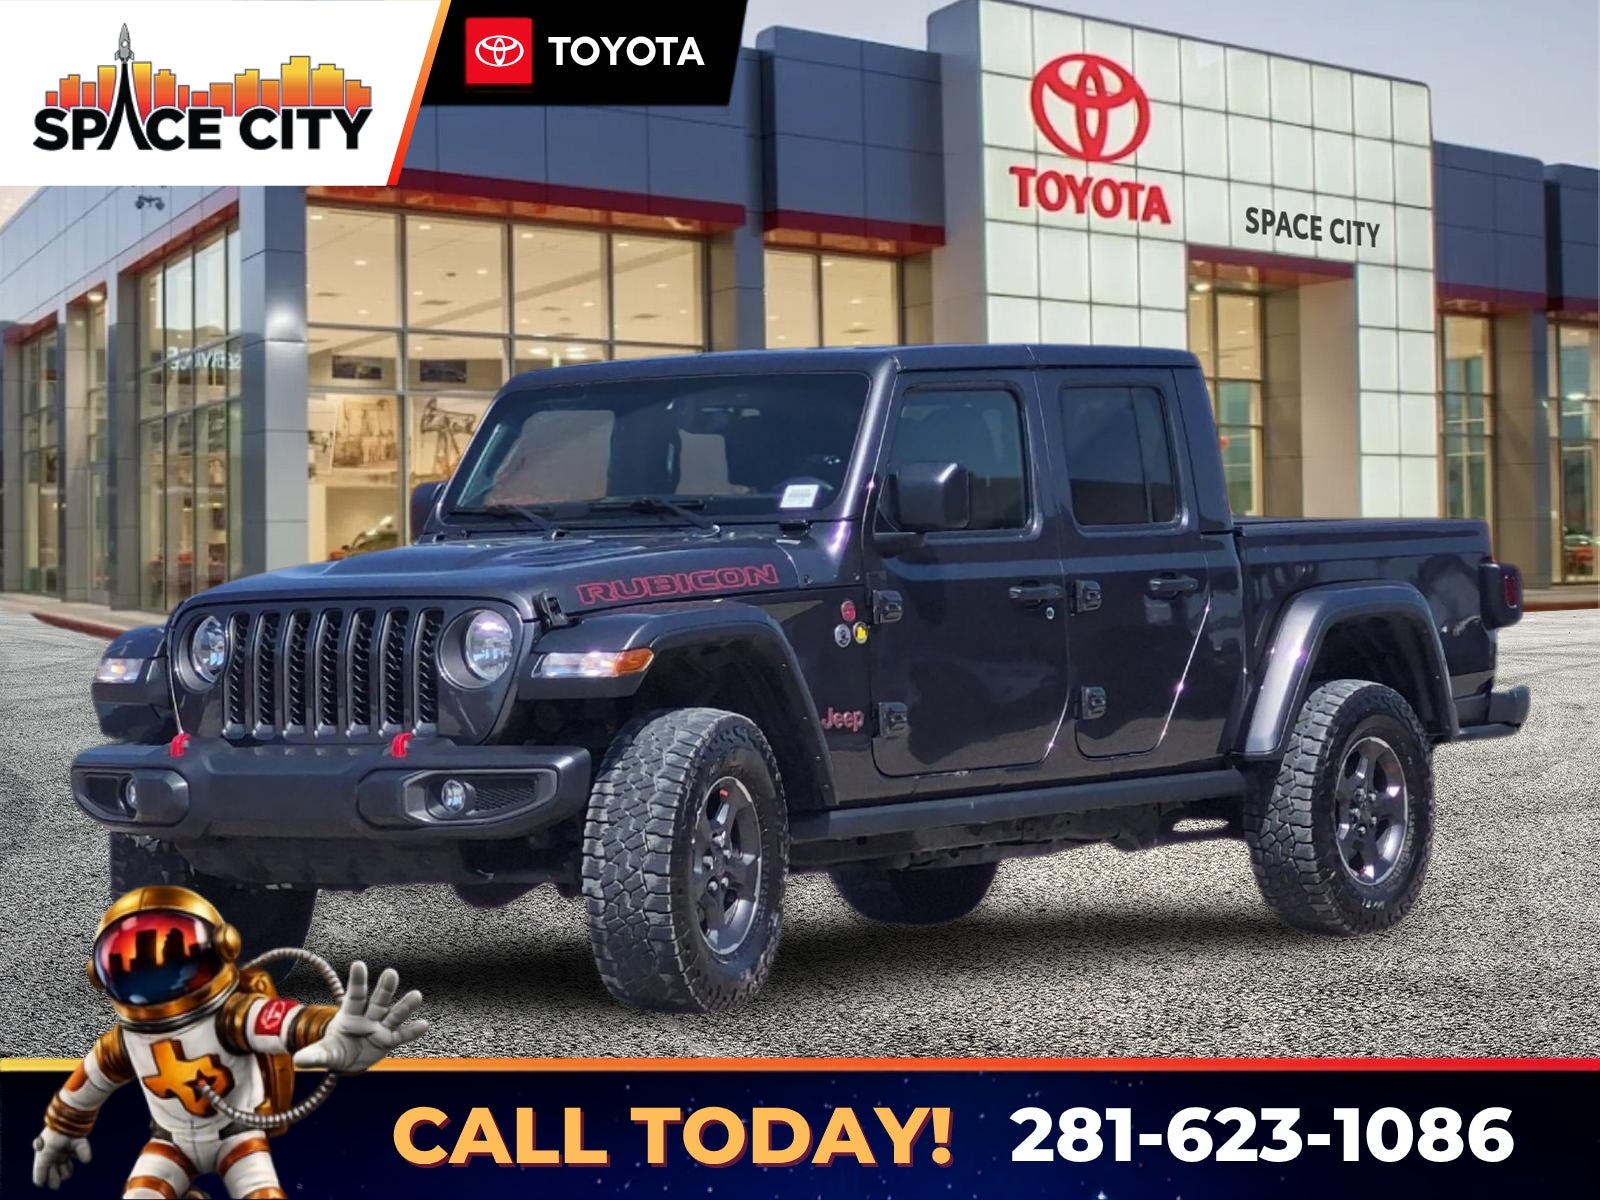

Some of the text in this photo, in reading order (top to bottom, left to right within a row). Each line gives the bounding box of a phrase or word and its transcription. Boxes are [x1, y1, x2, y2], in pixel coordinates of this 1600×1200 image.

[1009, 166, 1170, 225] TOYOTA
[1245, 206, 1380, 248] SPACE CITY
[577, 563, 779, 604] RUBICON
[821, 706, 864, 732] Jeep
